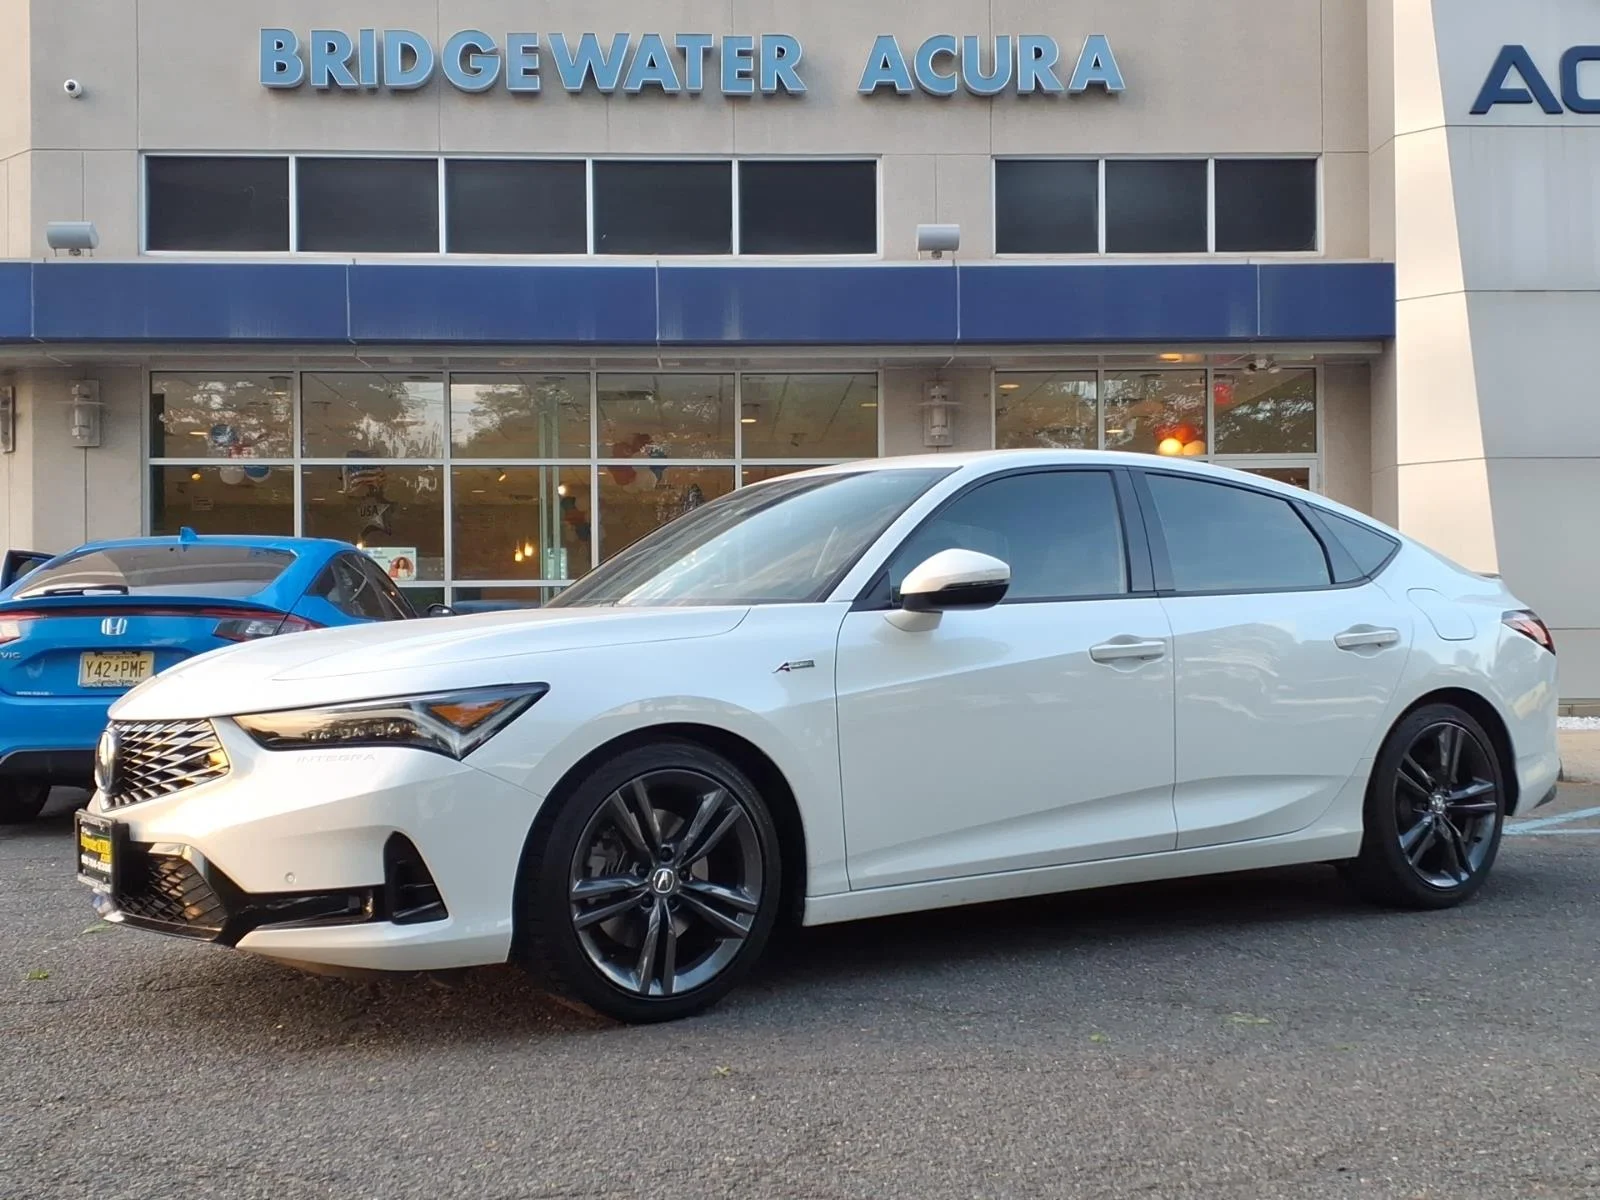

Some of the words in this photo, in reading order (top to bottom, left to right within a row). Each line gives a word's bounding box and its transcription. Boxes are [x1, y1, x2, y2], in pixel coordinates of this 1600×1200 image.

[259, 28, 808, 96] BRIDGEWATER
[857, 34, 1126, 96] ACURA
[360, 504, 379, 517] USA
[295, 752, 377, 764] INTEGRA
